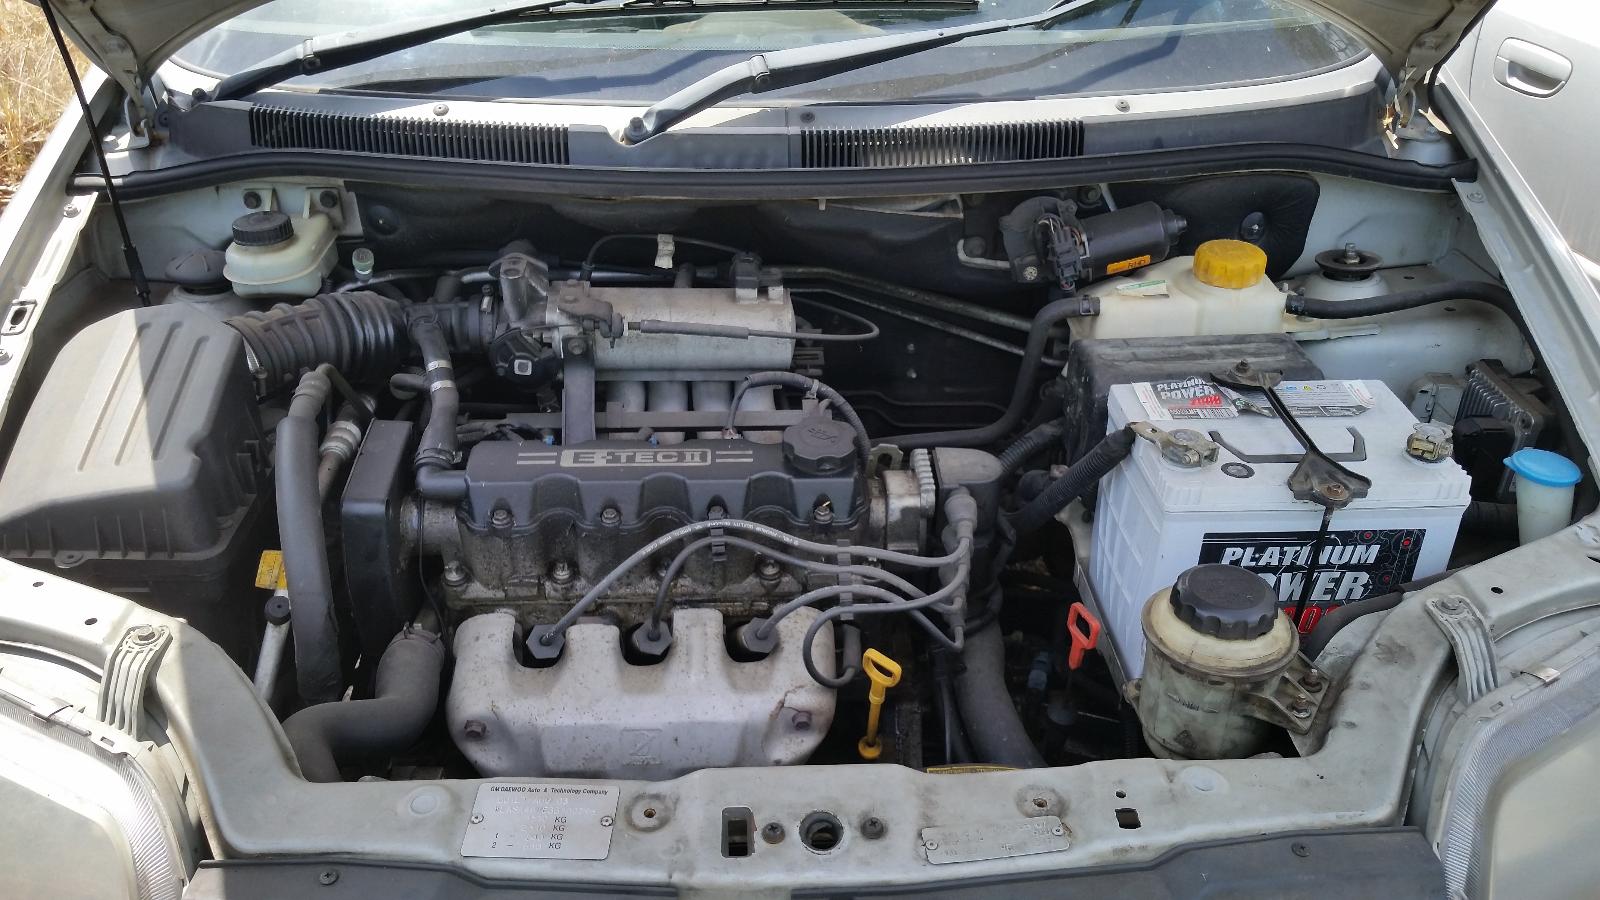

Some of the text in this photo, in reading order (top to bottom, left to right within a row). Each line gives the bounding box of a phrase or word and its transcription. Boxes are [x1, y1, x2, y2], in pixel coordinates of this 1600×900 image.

[1257, 571, 1372, 601] WER
[551, 787, 582, 795] Technology
[582, 788, 608, 796] Company
[550, 833, 563, 841] KG
[548, 842, 562, 850] KG
